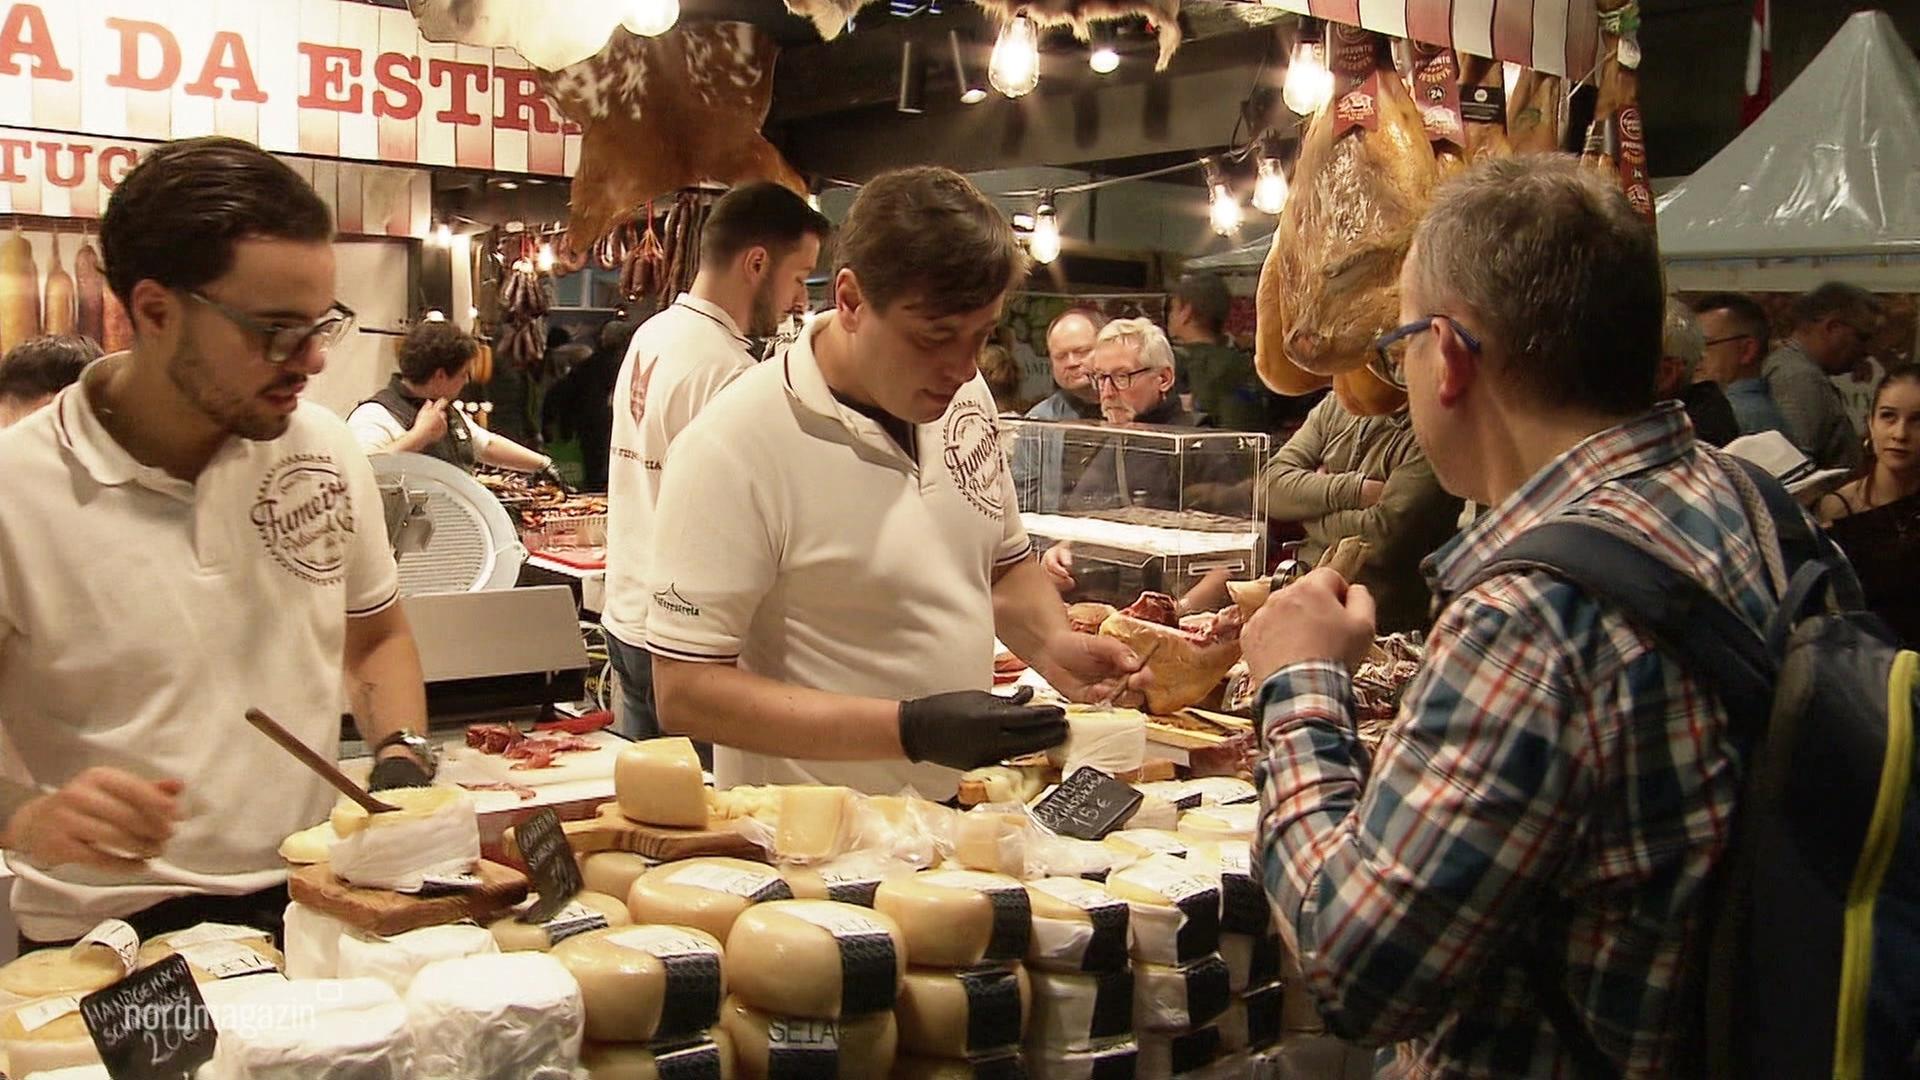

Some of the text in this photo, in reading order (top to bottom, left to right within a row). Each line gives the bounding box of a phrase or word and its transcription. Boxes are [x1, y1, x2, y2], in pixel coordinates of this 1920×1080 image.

[0, 3, 582, 136] A DA ESTR
